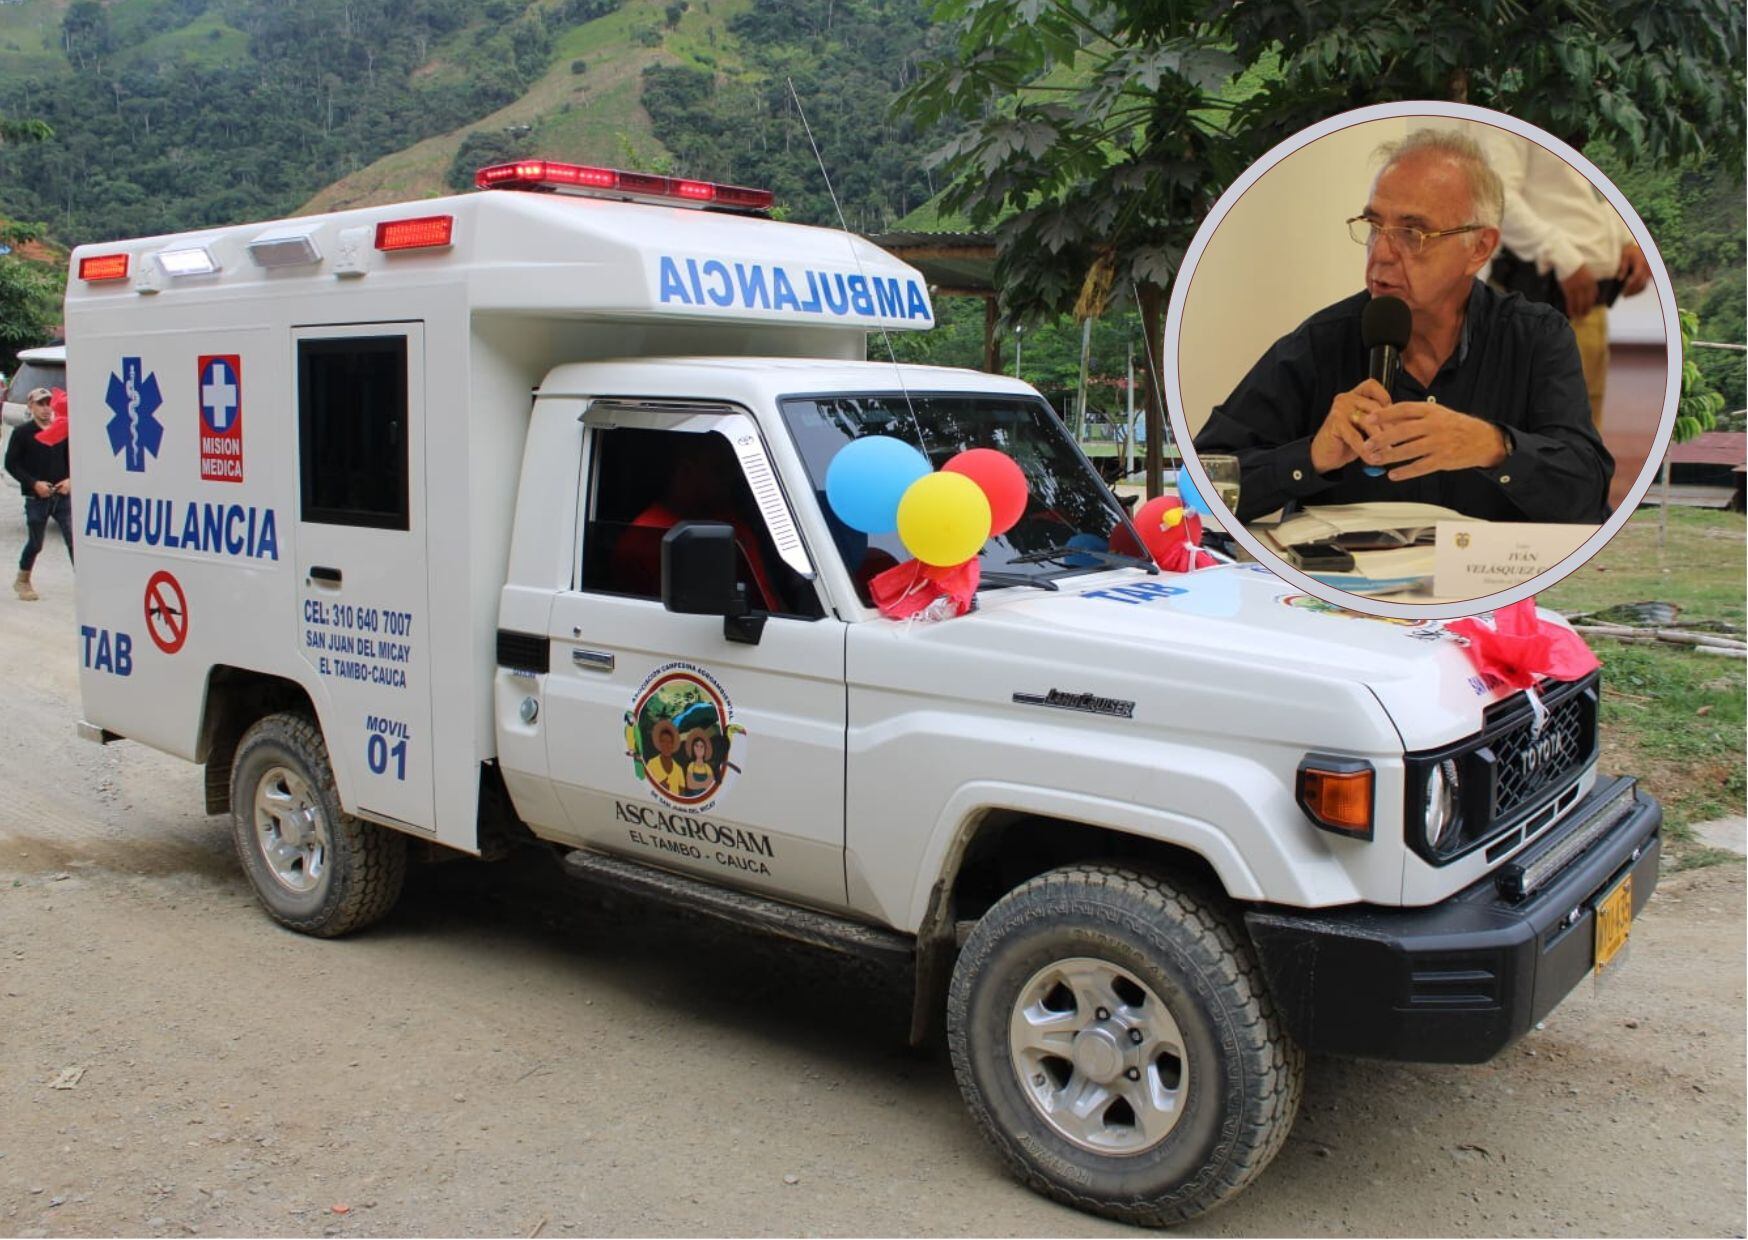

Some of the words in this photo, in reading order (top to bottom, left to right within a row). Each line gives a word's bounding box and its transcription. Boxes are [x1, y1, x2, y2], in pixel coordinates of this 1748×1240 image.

[203, 437, 240, 455] MISION
[202, 458, 242, 477] MEDICA
[85, 492, 279, 561] AMBULANCIA
[1080, 581, 1190, 605] TAB
[304, 599, 329, 625] CEL:
[333, 603, 353, 628] 310
[357, 606, 378, 632] 640
[382, 610, 412, 637] 7007
[81, 625, 132, 677] TAB
[306, 629, 326, 650] SAN
[328, 633, 354, 654] JUAN
[357, 638, 376, 658] DEL
[378, 640, 411, 663] MICAY
[319, 656, 331, 675] EL
[366, 715, 410, 740] MOVIL
[368, 733, 406, 781] 01
[1520, 731, 1563, 776] TOYOTA
[615, 800, 775, 858] ASCAGROSAM
[629, 830, 648, 845] EL
[652, 835, 701, 859] TAMBO
[715, 851, 771, 876] CAUCA
